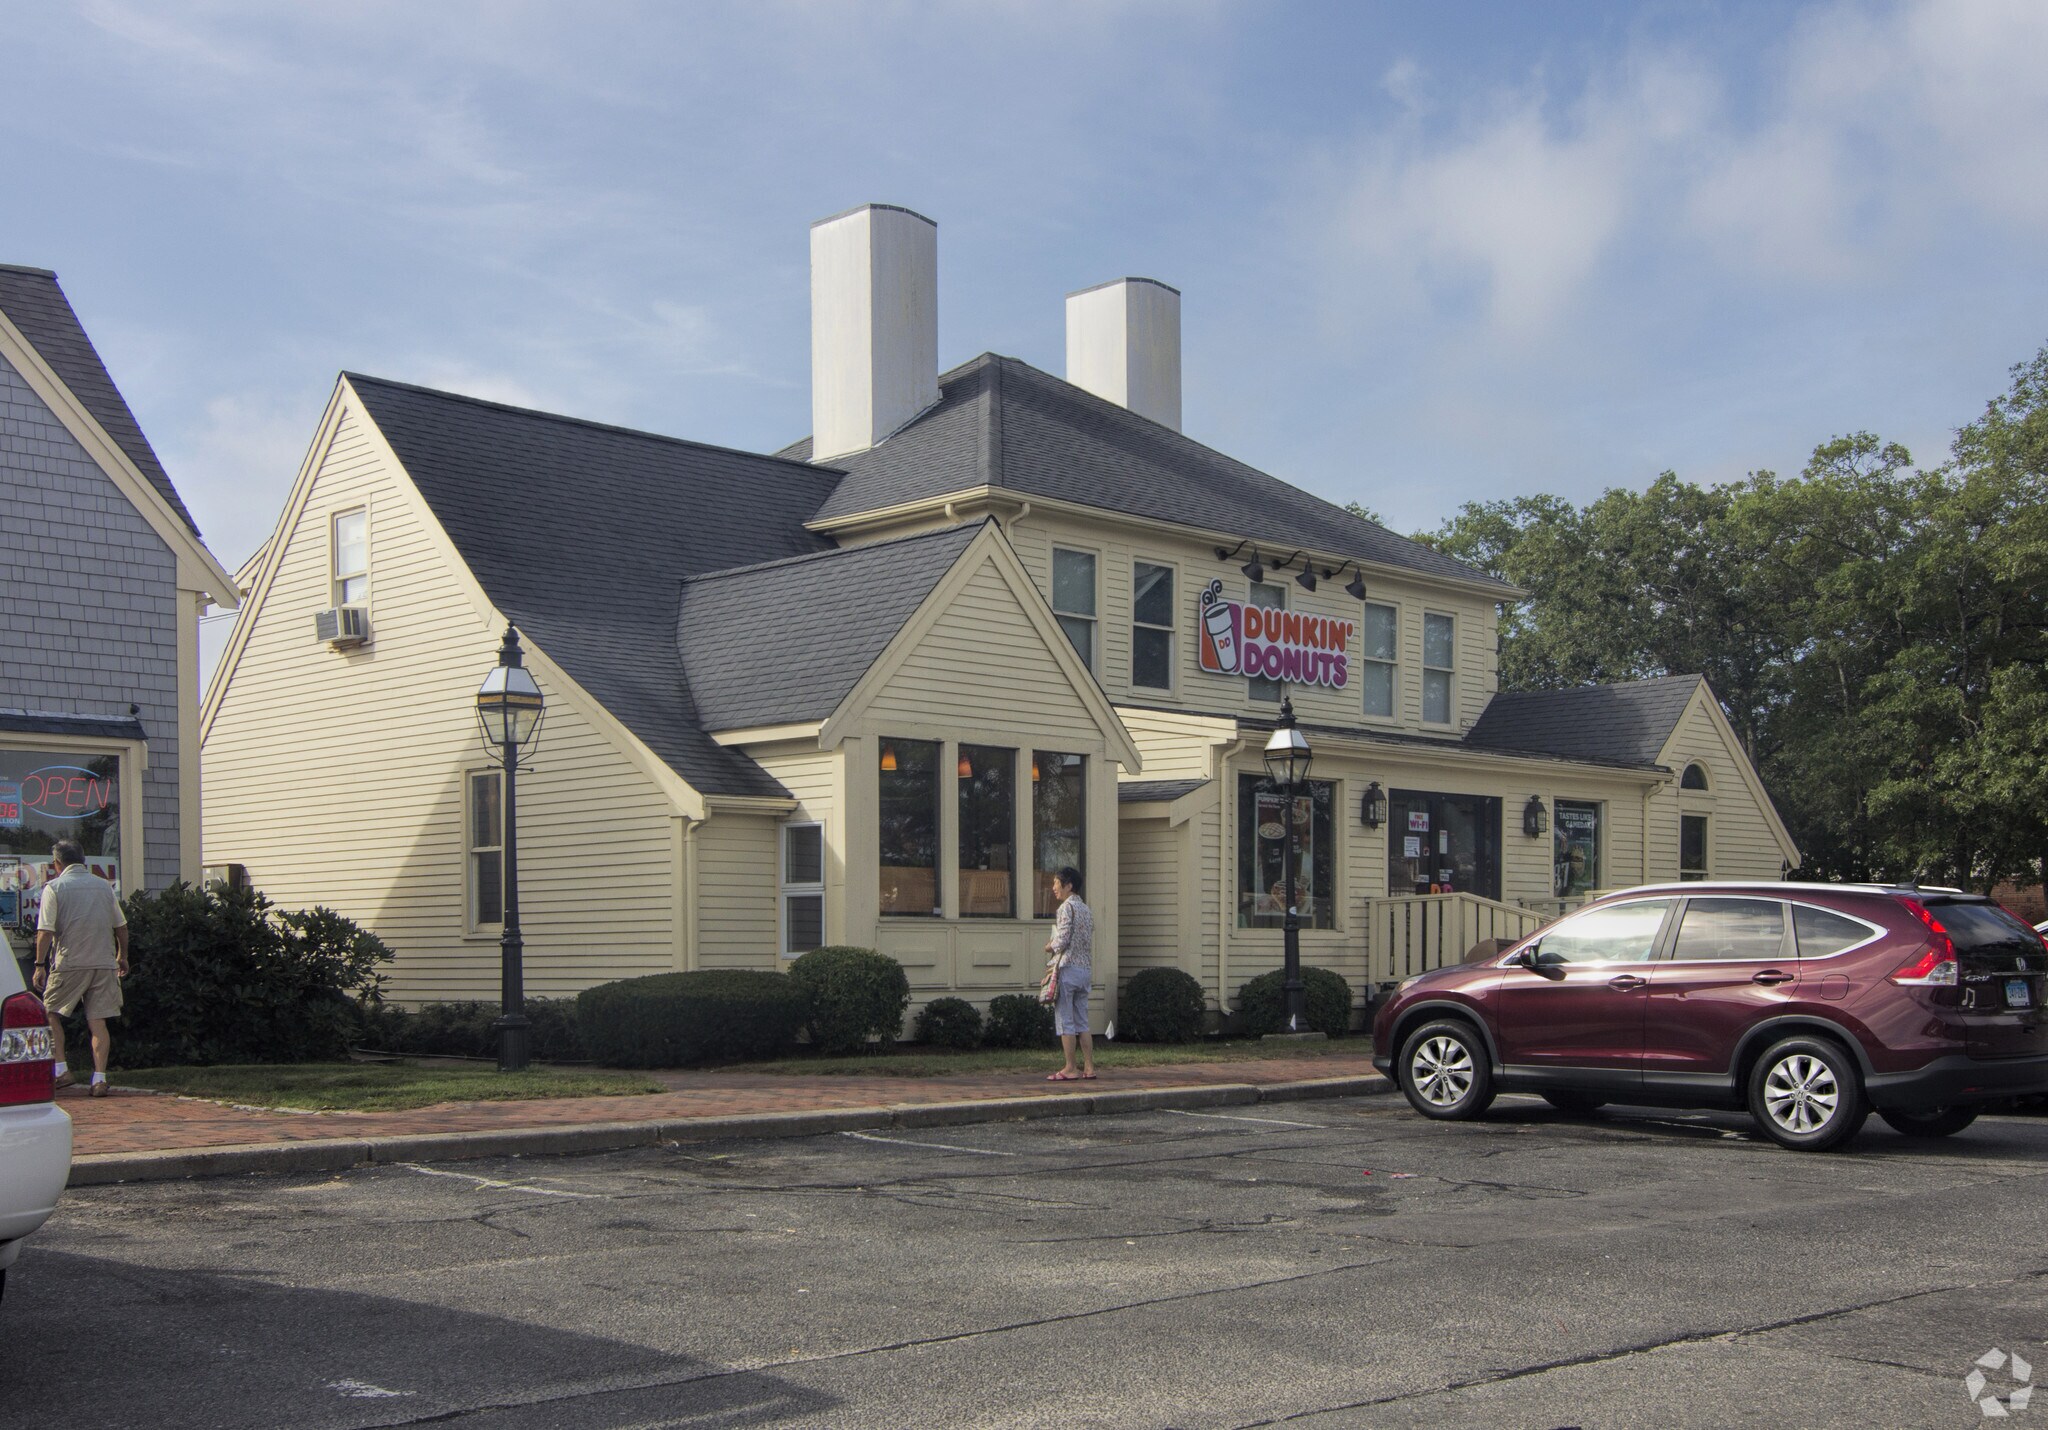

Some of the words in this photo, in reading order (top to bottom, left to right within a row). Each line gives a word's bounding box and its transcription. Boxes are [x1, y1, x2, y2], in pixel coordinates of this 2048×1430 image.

[1218, 636, 1231, 650] DD
[1244, 606, 1353, 652] DUNKIN'
[1244, 642, 1348, 687] DONUTS
[21, 775, 110, 808] OPEN
[1559, 812, 1579, 820] TASTES
[1580, 813, 1592, 821] LIKE
[17, 863, 116, 890] OPN
